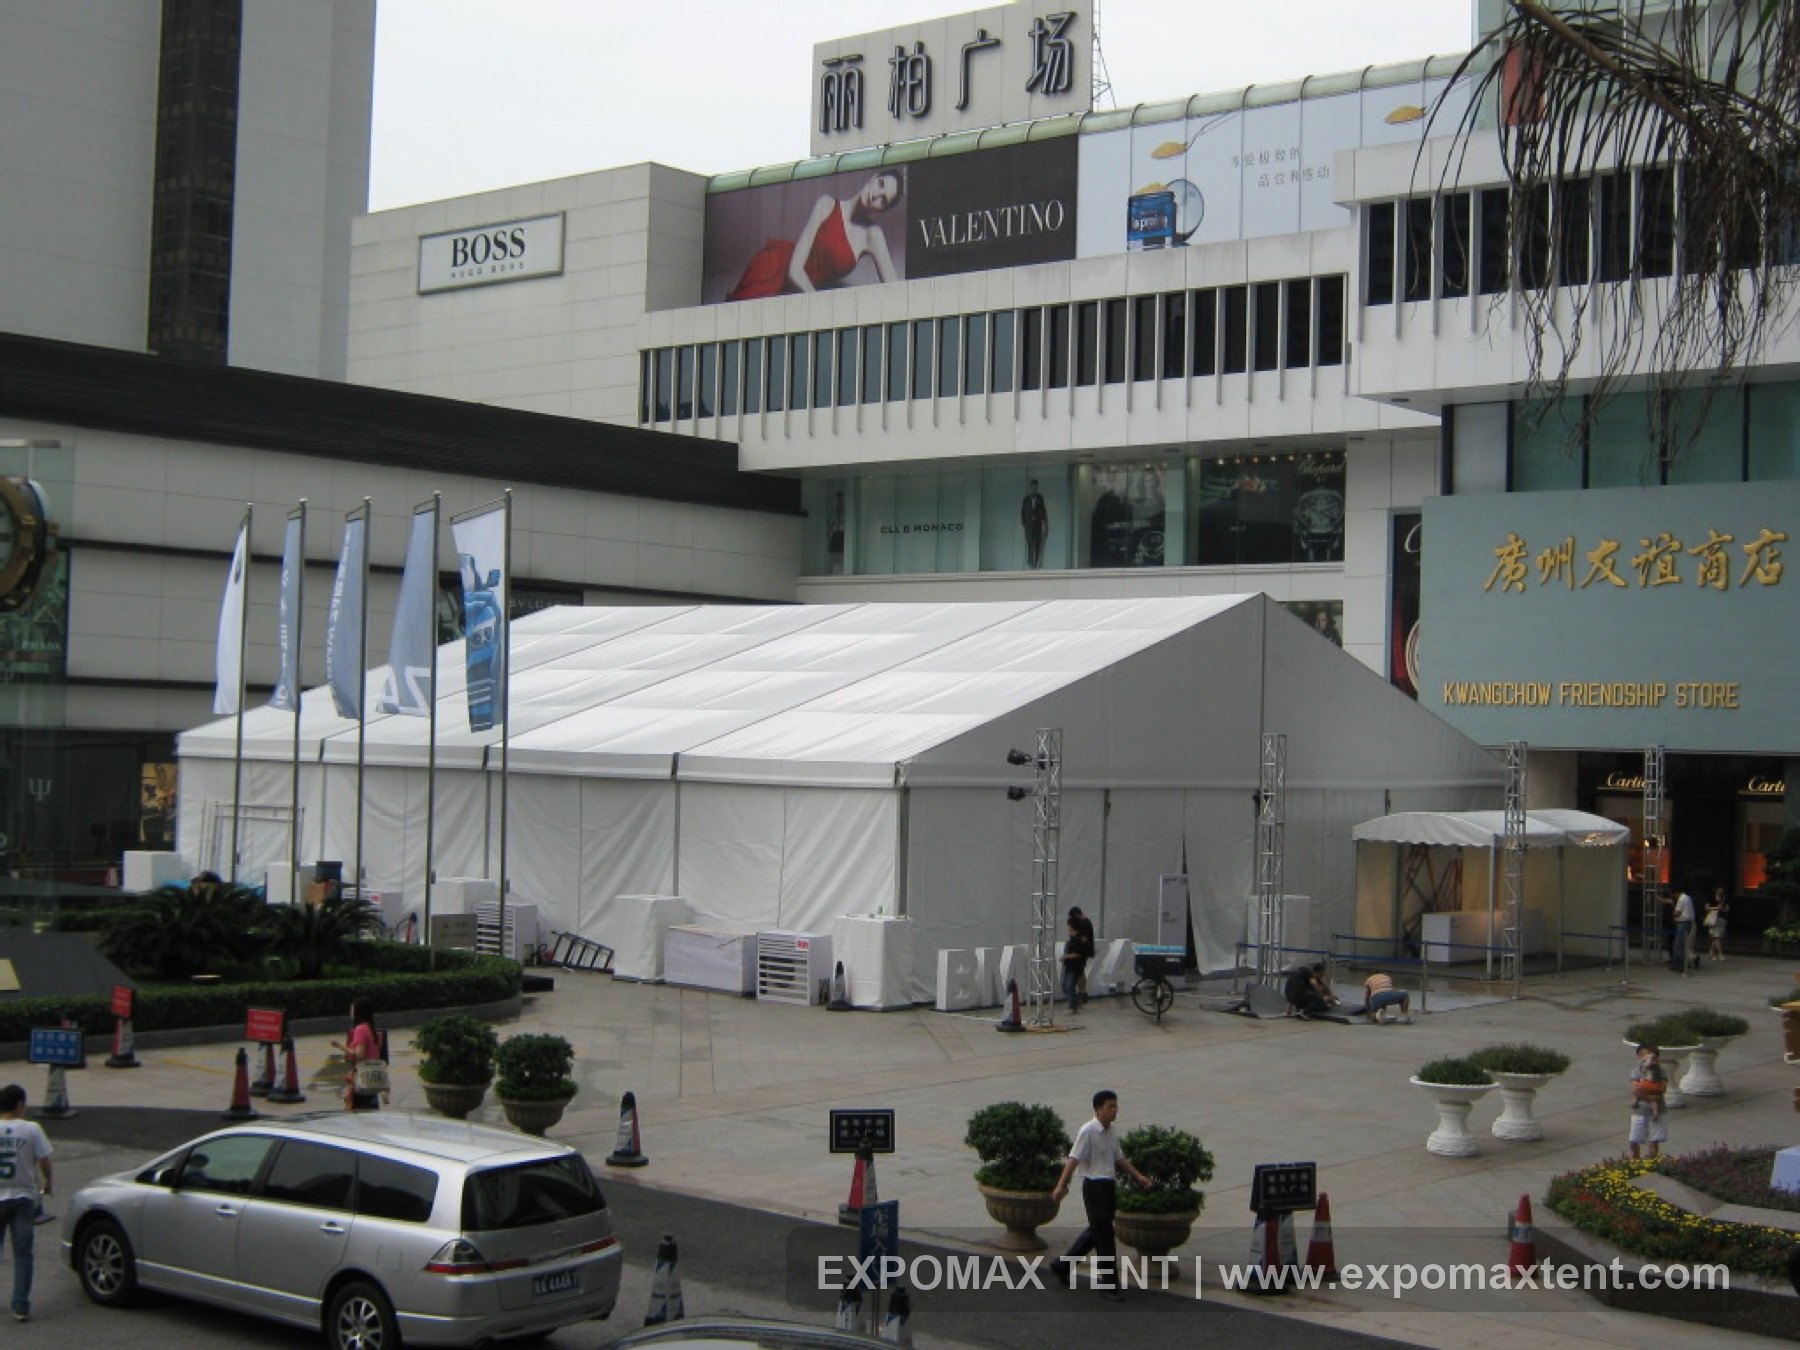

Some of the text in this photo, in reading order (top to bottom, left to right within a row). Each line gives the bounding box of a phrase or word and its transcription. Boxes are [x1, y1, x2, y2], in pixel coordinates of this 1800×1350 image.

[818, 11, 1078, 134] 丽柏广场
[919, 199, 1065, 249] VALENTINO
[450, 227, 526, 268] BOSS
[913, 523, 965, 533] MONACO
[1484, 528, 1787, 593] 廣州友誼商店
[1443, 682, 1740, 709] KWANGCHOW FRIENDSHIP STORE
